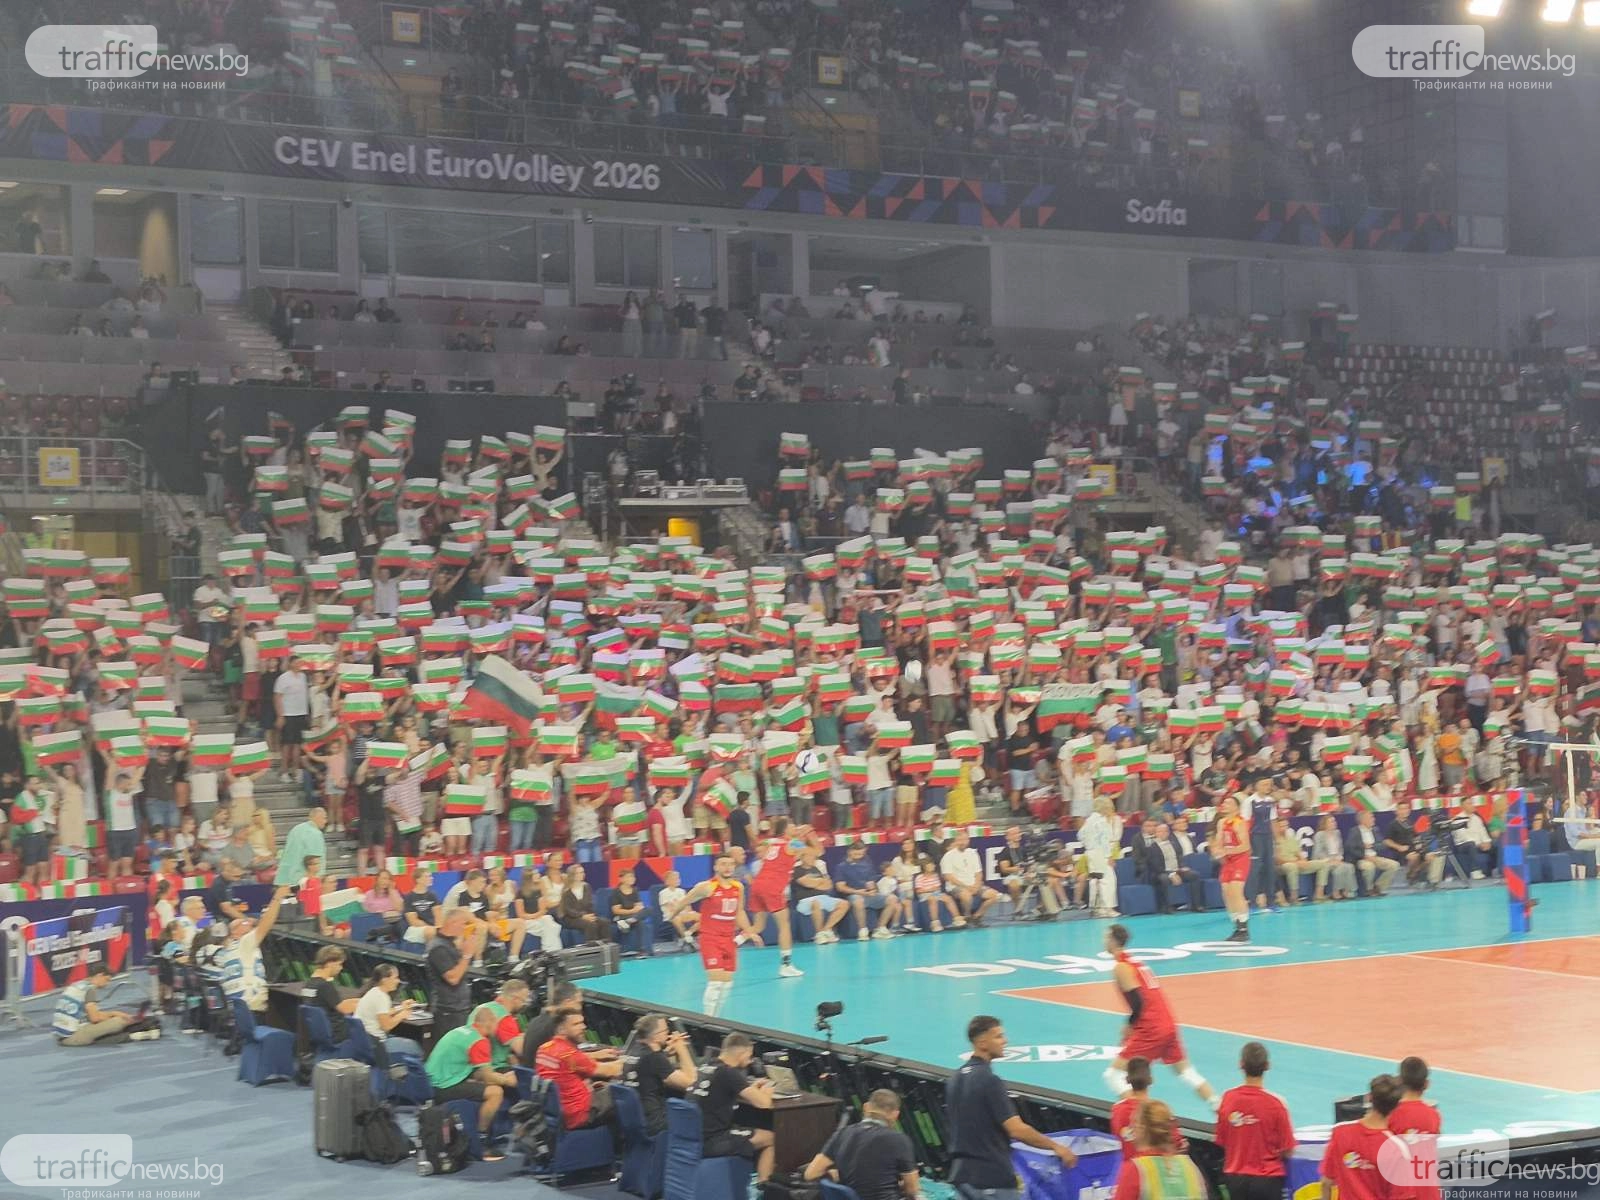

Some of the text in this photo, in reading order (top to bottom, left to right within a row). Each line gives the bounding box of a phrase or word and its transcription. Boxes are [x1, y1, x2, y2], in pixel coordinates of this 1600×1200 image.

[274, 136, 661, 192] CEV Enel EuroVolley 2026
[1126, 198, 1187, 226] Sofia
